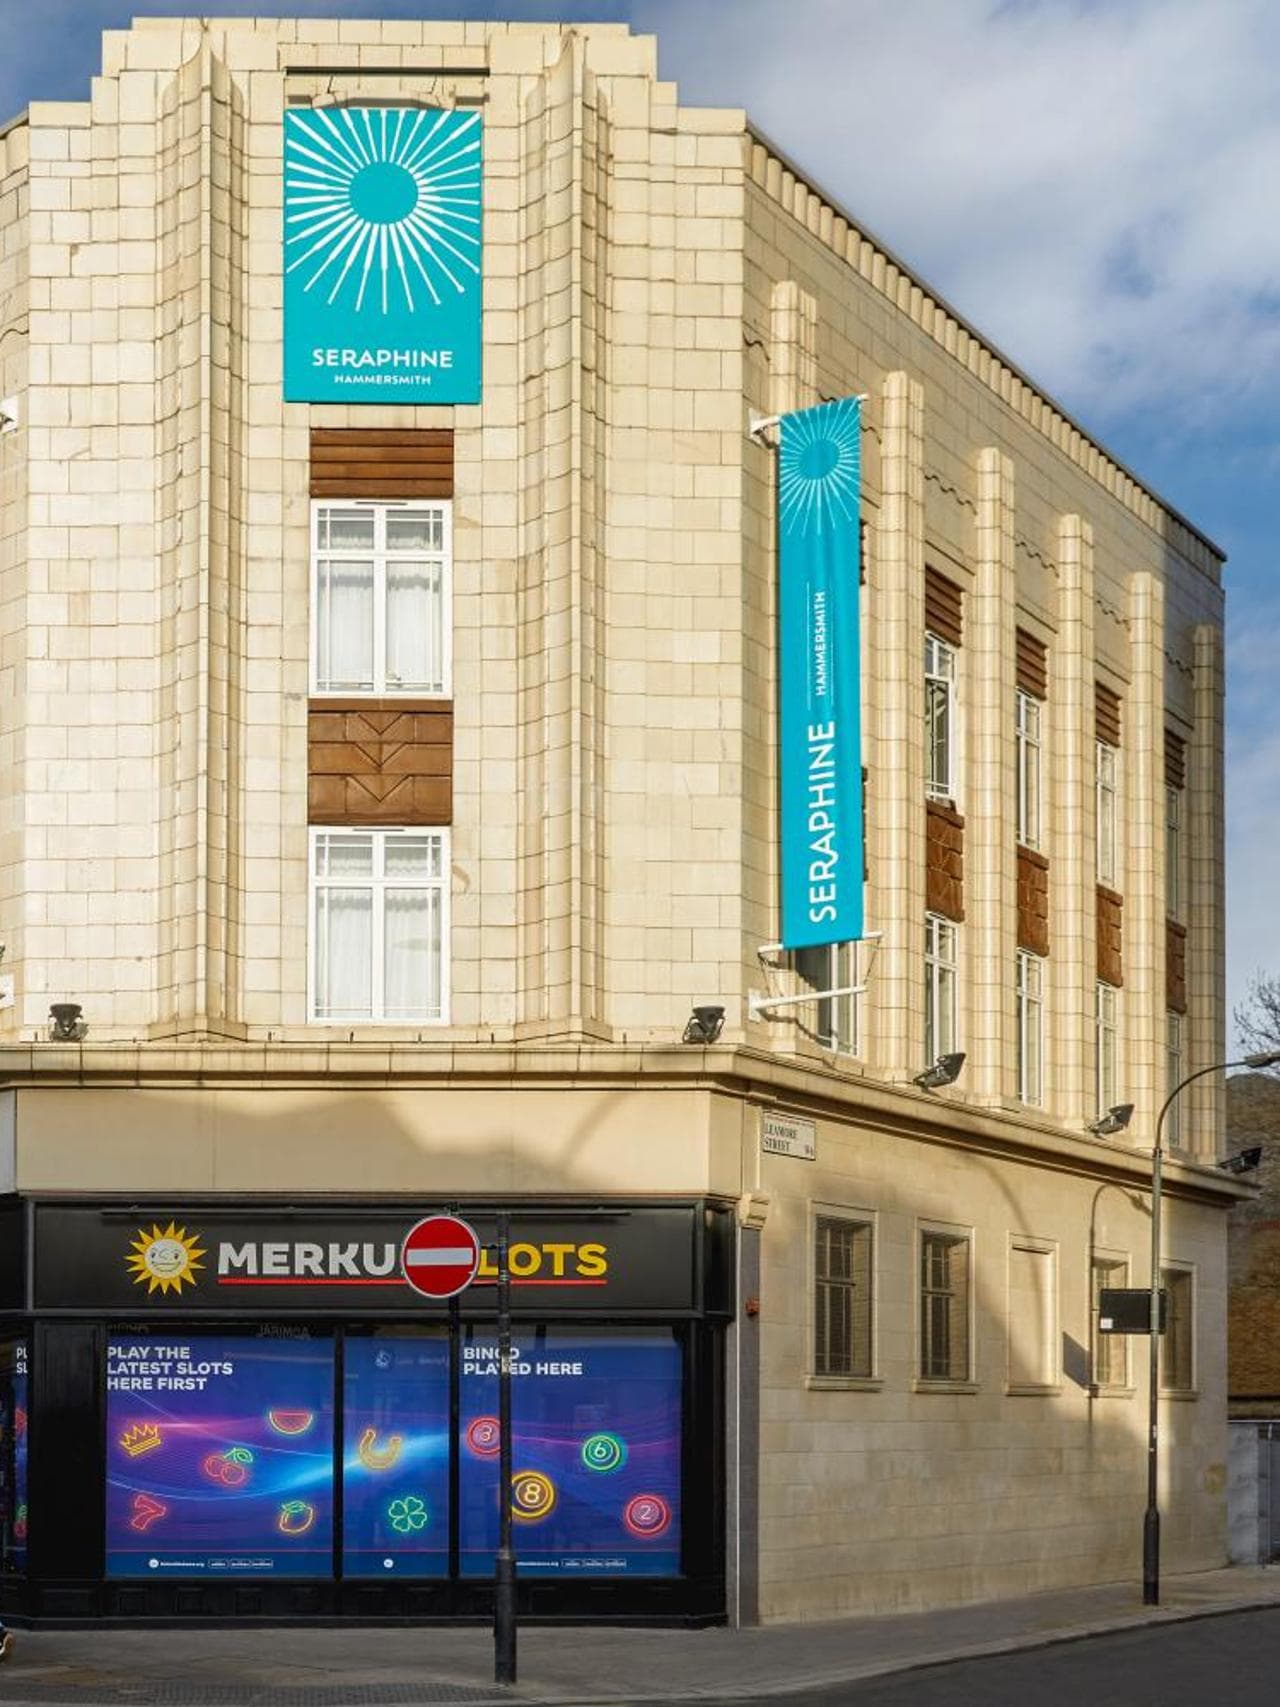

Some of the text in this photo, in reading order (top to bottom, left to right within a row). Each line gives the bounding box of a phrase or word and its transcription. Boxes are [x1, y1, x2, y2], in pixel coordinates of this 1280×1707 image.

[312, 348, 453, 368] SERAPHINE
[334, 374, 431, 385] HAMMERSMITH
[814, 591, 827, 696] HAMMERSMITH
[808, 720, 839, 924] SERAPHINE
[218, 1242, 608, 1276] MERKU LOTS
[107, 1346, 190, 1359] PLAY THE
[107, 1362, 234, 1375] LATEST SLOTS
[463, 1363, 584, 1376] PLAED HERE
[107, 1377, 208, 1390] HERE FIRST
[480, 1425, 493, 1442] 3
[595, 1442, 607, 1458] 6
[523, 1482, 540, 1503] 8
[639, 1505, 651, 1520] 2
